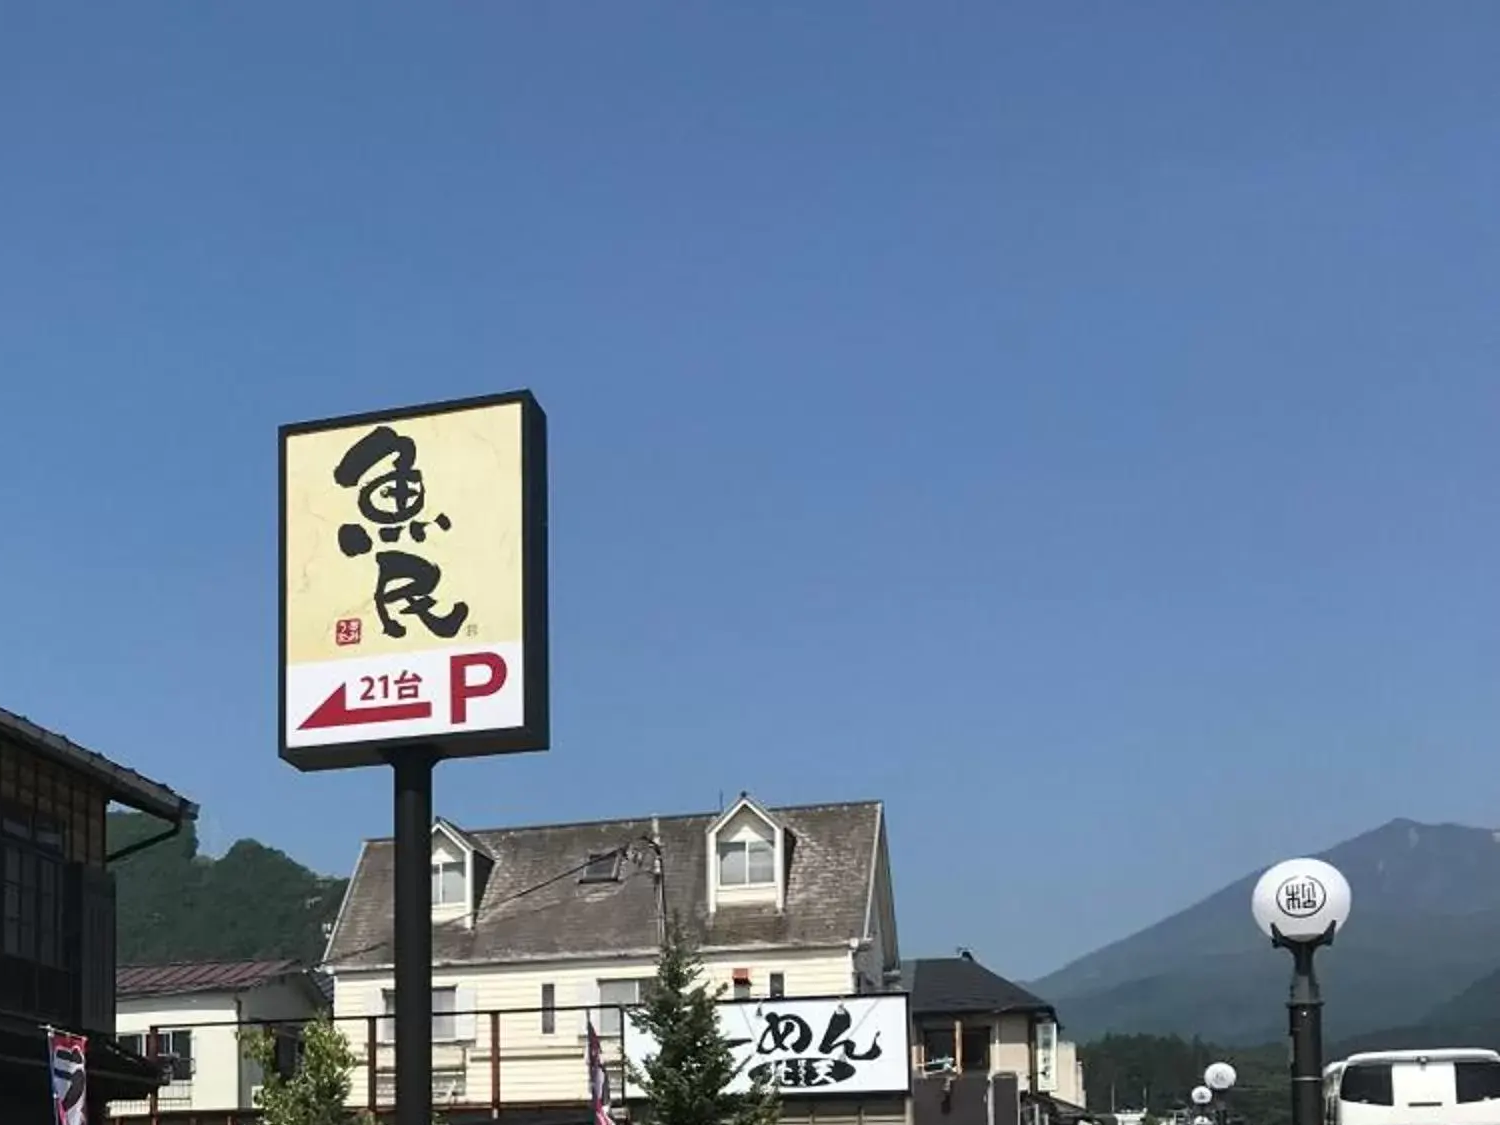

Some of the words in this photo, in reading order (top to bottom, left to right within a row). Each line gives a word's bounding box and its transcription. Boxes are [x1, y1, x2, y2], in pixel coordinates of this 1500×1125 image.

[334, 426, 469, 639] 魚民
[359, 669, 423, 703] 21台
[449, 651, 508, 725] P
